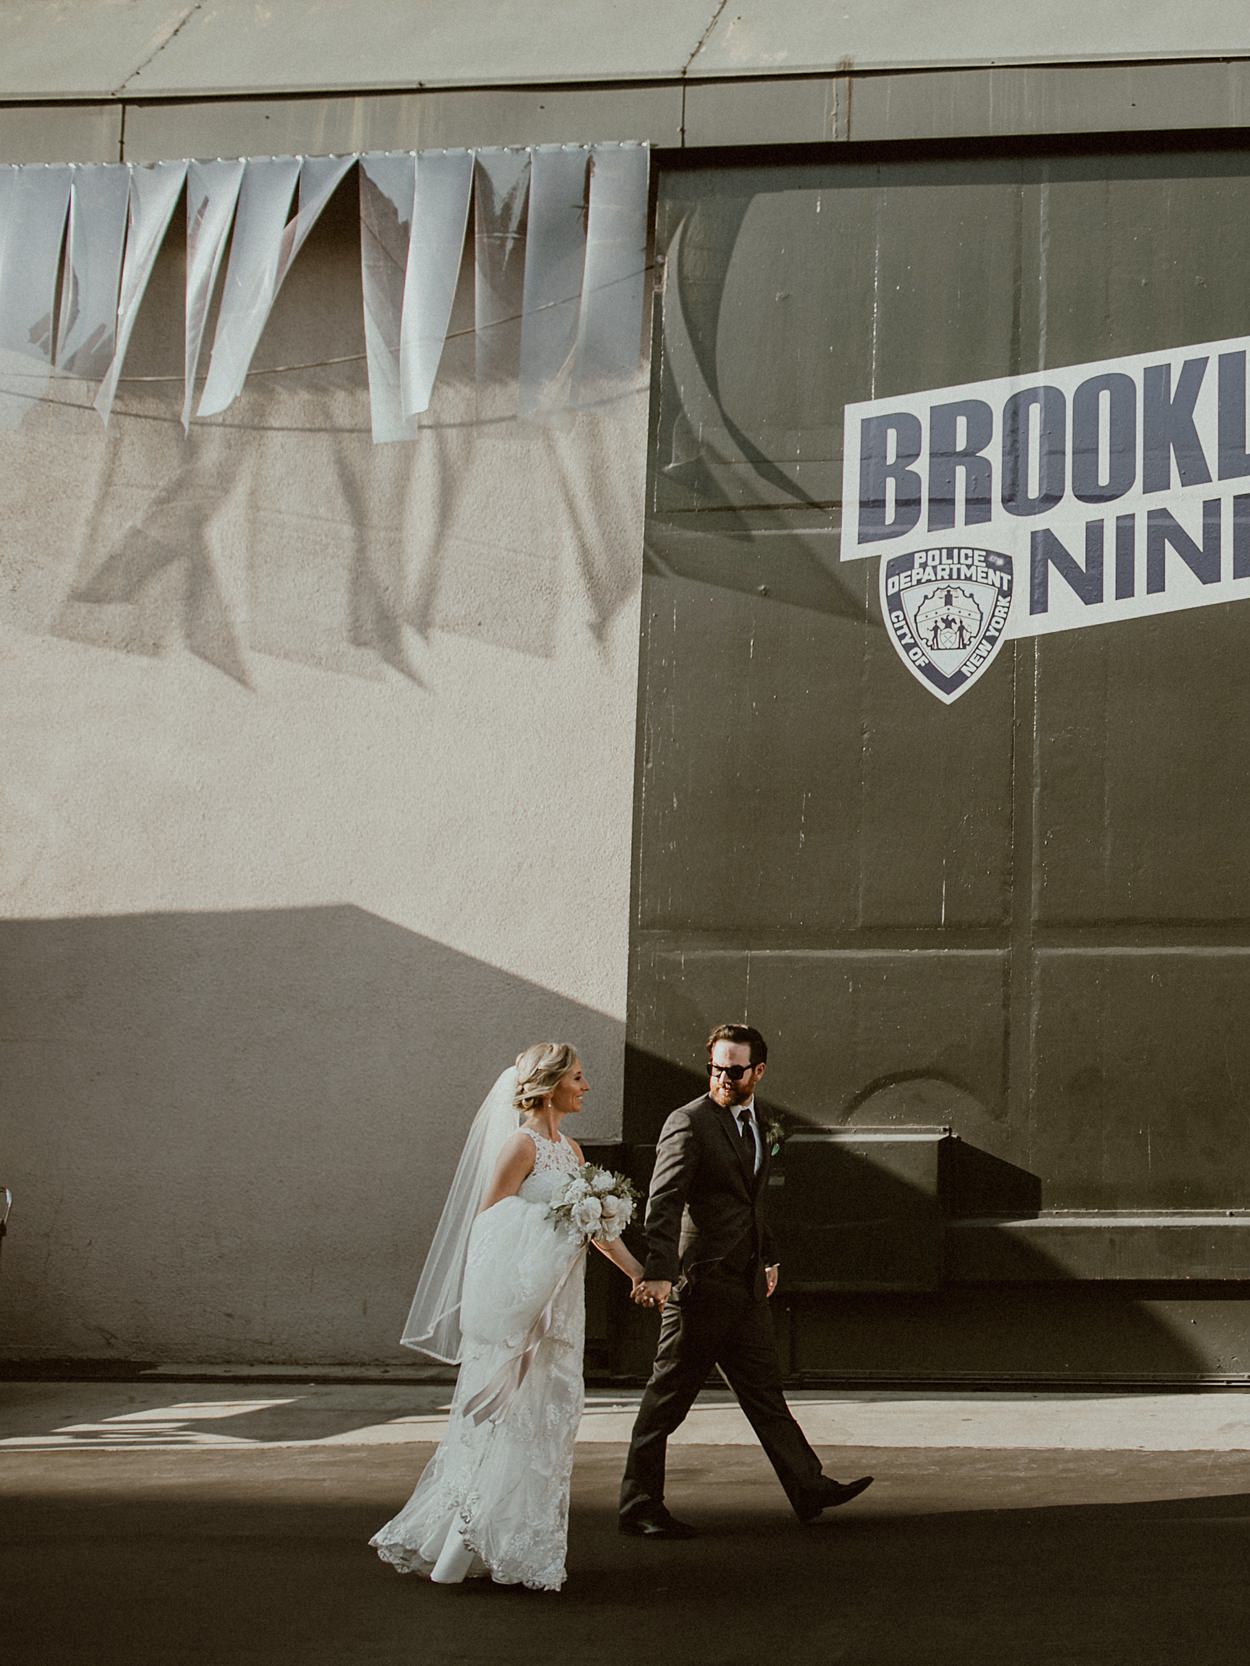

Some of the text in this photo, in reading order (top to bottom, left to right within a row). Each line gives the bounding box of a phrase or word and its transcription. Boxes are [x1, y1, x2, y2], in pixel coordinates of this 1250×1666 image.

[914, 549, 986, 568] POLICE
[887, 565, 1011, 596] DEPARTMENT
[891, 611, 930, 667] CITY OF
[960, 595, 1011, 676] NEW YORK
